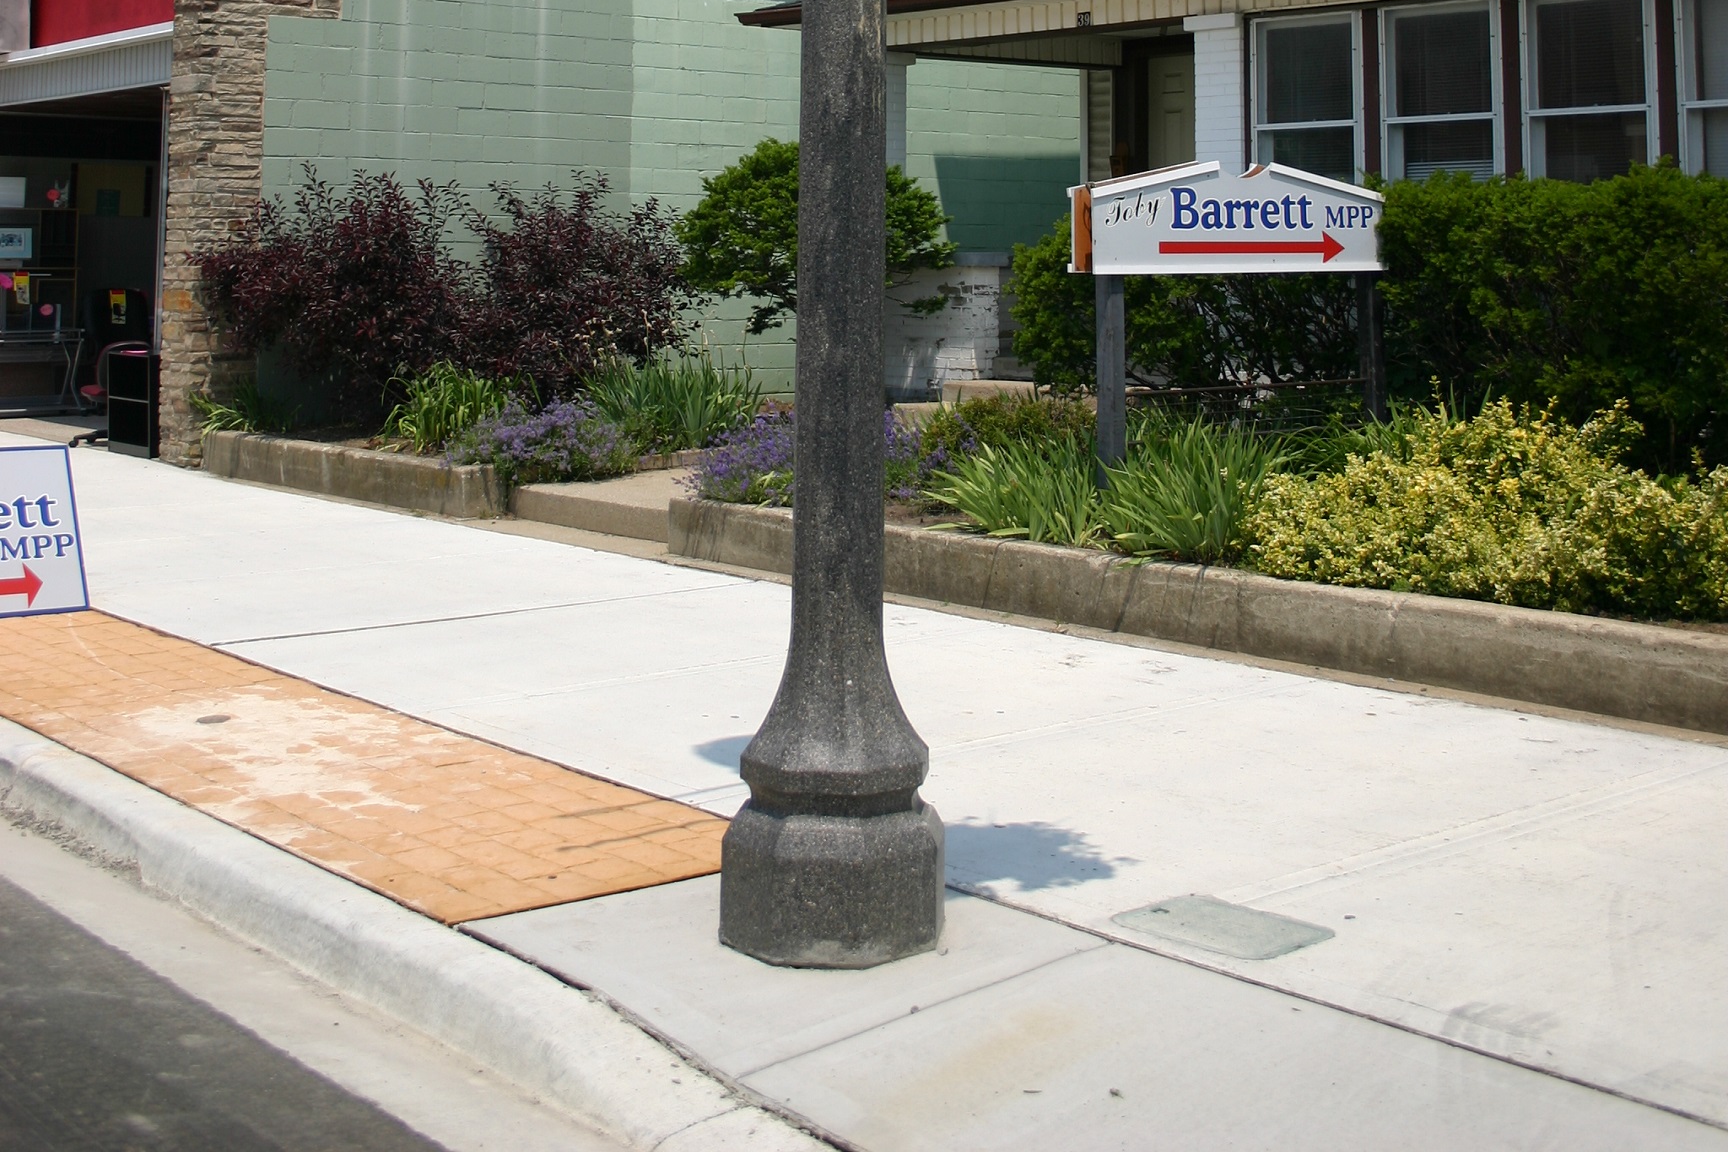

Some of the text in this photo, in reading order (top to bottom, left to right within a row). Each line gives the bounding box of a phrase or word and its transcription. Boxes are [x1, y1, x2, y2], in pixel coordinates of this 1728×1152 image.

[1105, 186, 1374, 230] Toby Barrett MPP
[0, 532, 75, 561] MPP
